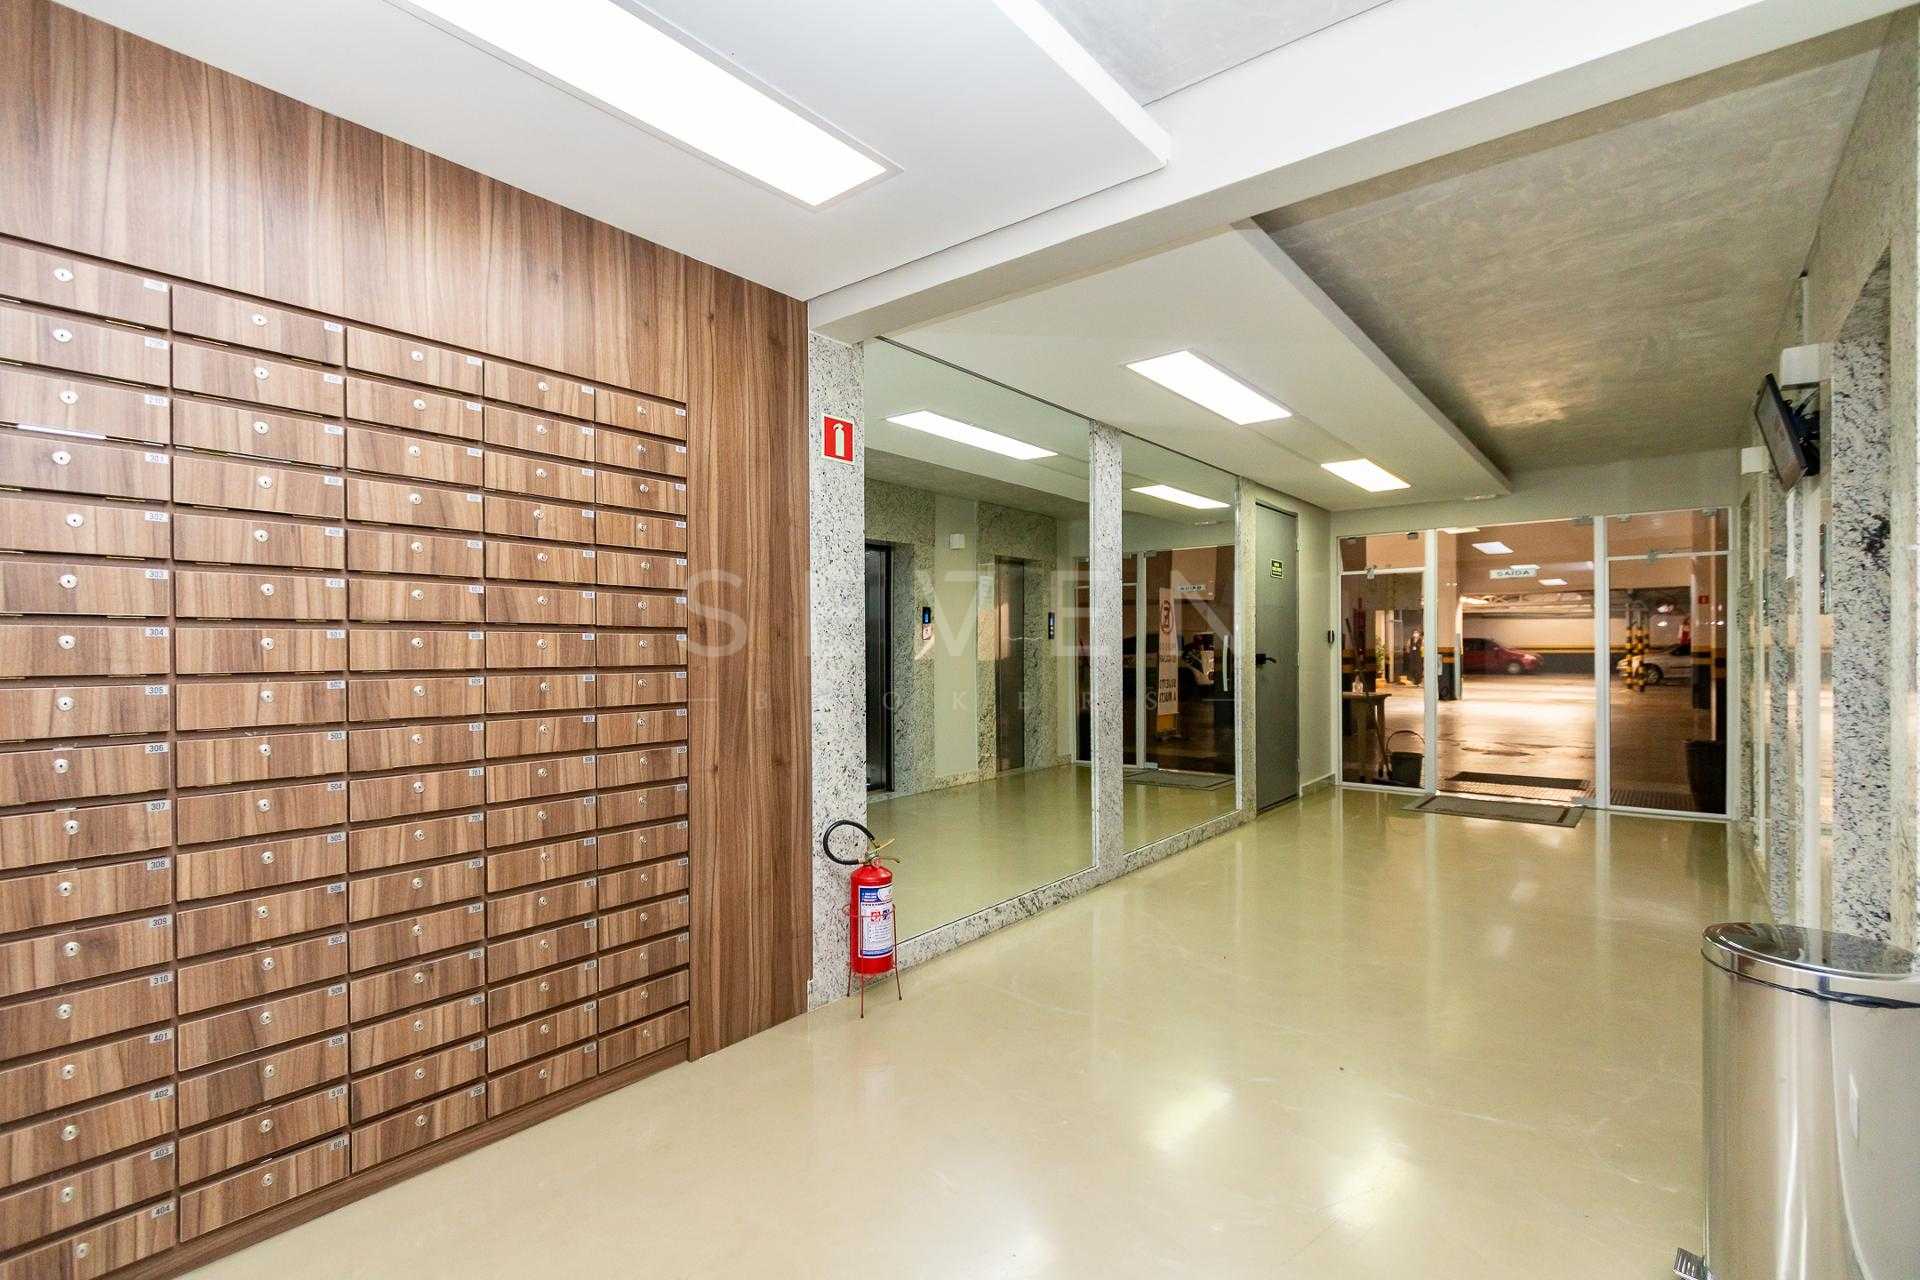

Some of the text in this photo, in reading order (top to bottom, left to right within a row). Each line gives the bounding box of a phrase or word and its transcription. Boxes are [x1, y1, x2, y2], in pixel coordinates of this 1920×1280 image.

[149, 628, 164, 636] 304
[148, 686, 164, 694] 305
[148, 744, 164, 752] 306
[151, 802, 166, 811] 307
[150, 860, 166, 869] 308
[153, 974, 169, 985] 310
[153, 1032, 168, 1042] 401
[154, 1088, 169, 1099] 402
[155, 1147, 170, 1158] 403
[155, 1204, 170, 1215] 404
